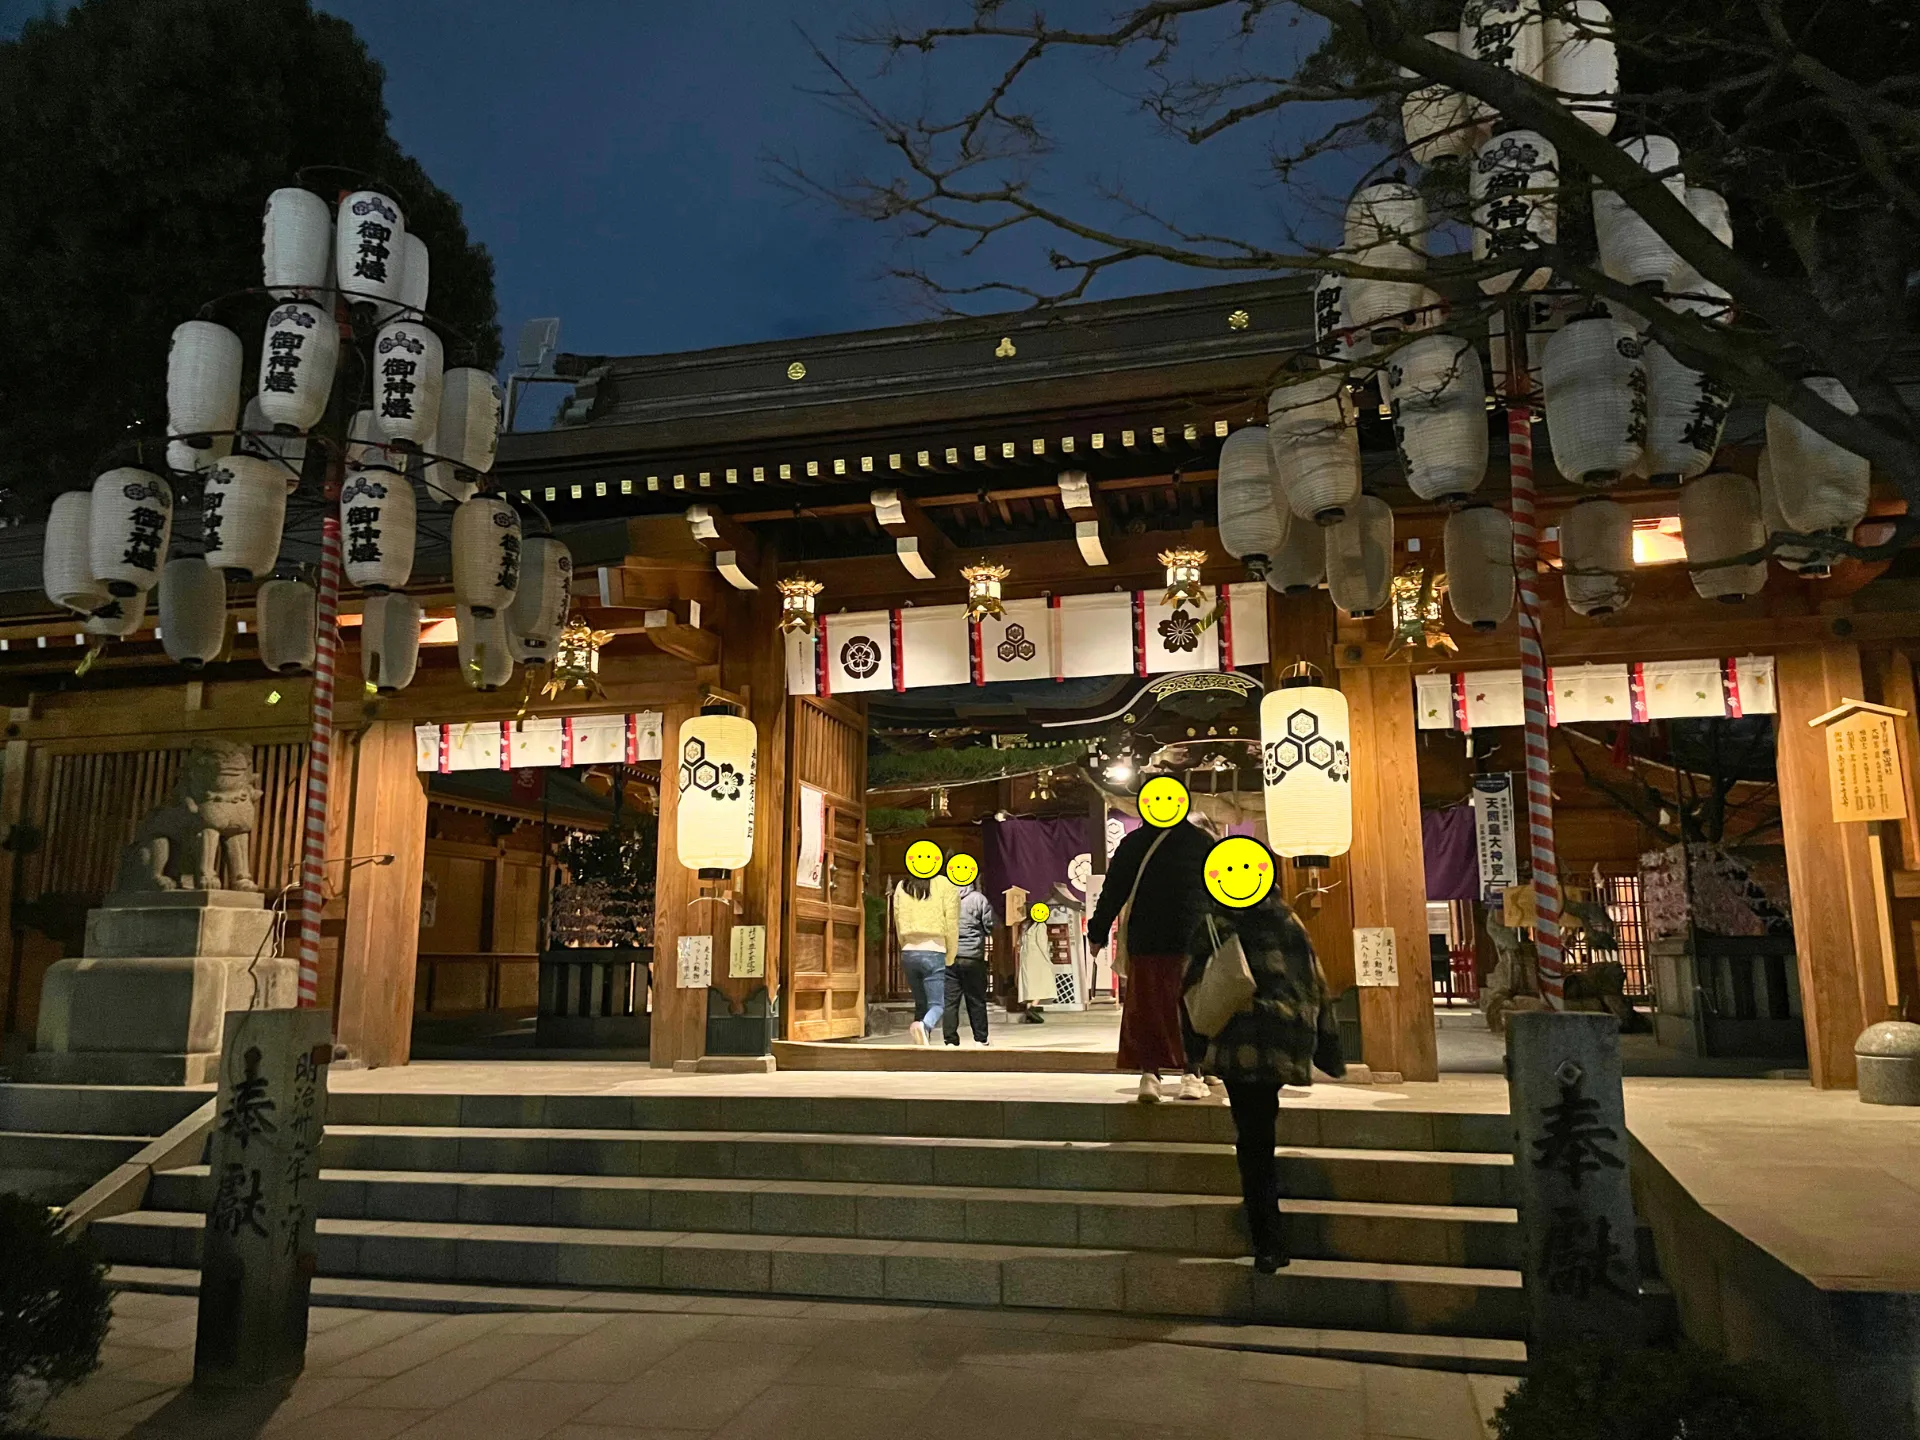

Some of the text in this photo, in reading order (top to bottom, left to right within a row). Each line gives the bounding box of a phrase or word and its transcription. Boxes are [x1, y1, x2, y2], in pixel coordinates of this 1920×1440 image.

[353, 220, 392, 284] 御神燈
[263, 330, 306, 394] 御神燈
[380, 357, 417, 420] 御神燈
[120, 506, 166, 572] 御神燈
[347, 506, 383, 564] 御神燈
